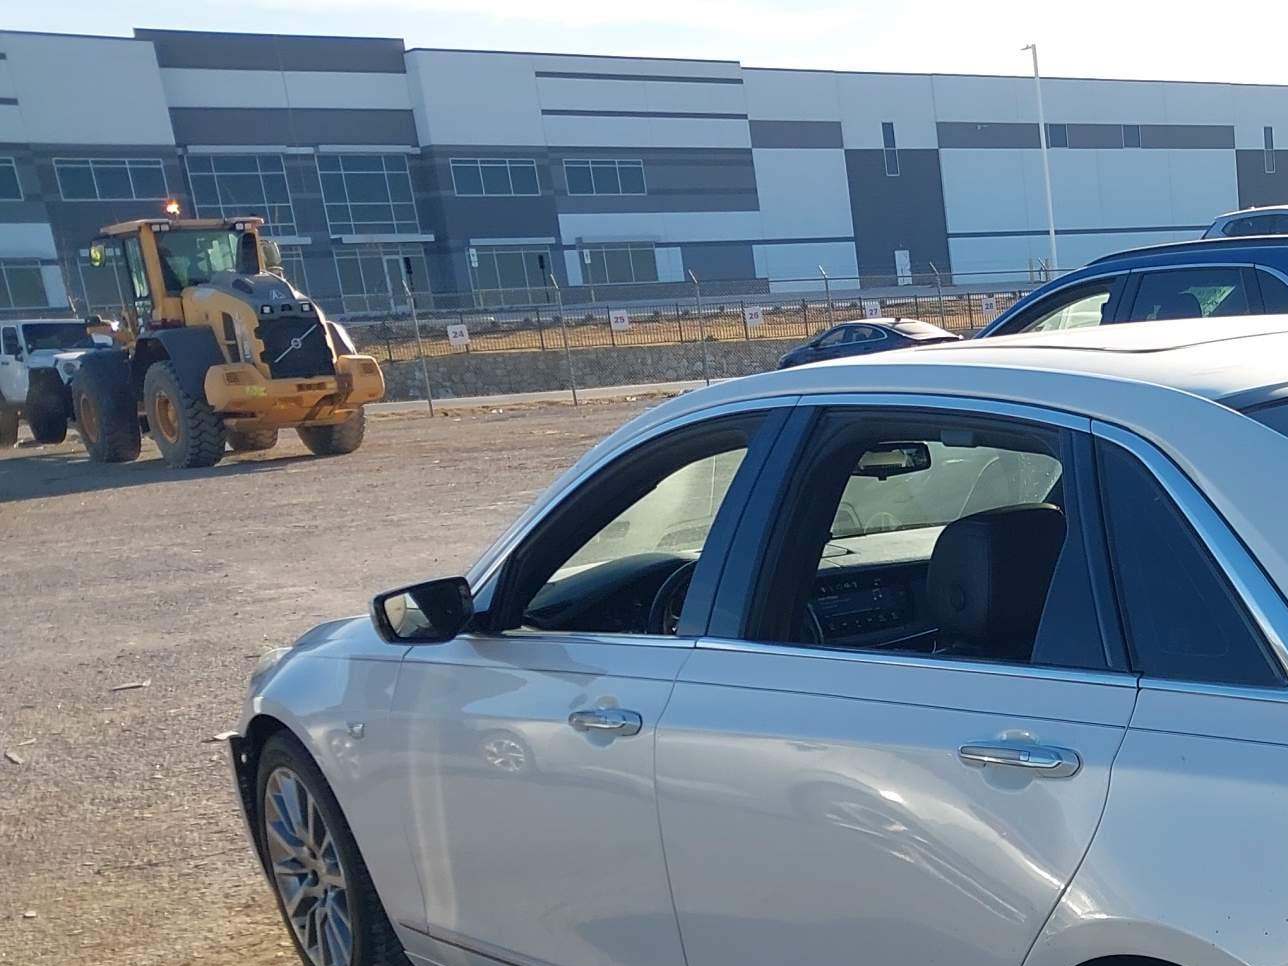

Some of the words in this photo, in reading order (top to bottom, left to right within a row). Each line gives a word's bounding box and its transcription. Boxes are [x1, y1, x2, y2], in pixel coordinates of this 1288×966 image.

[868, 307, 878, 316] 27
[613, 316, 625, 324] 25
[748, 312, 759, 320] 26
[452, 330, 465, 338] 24
